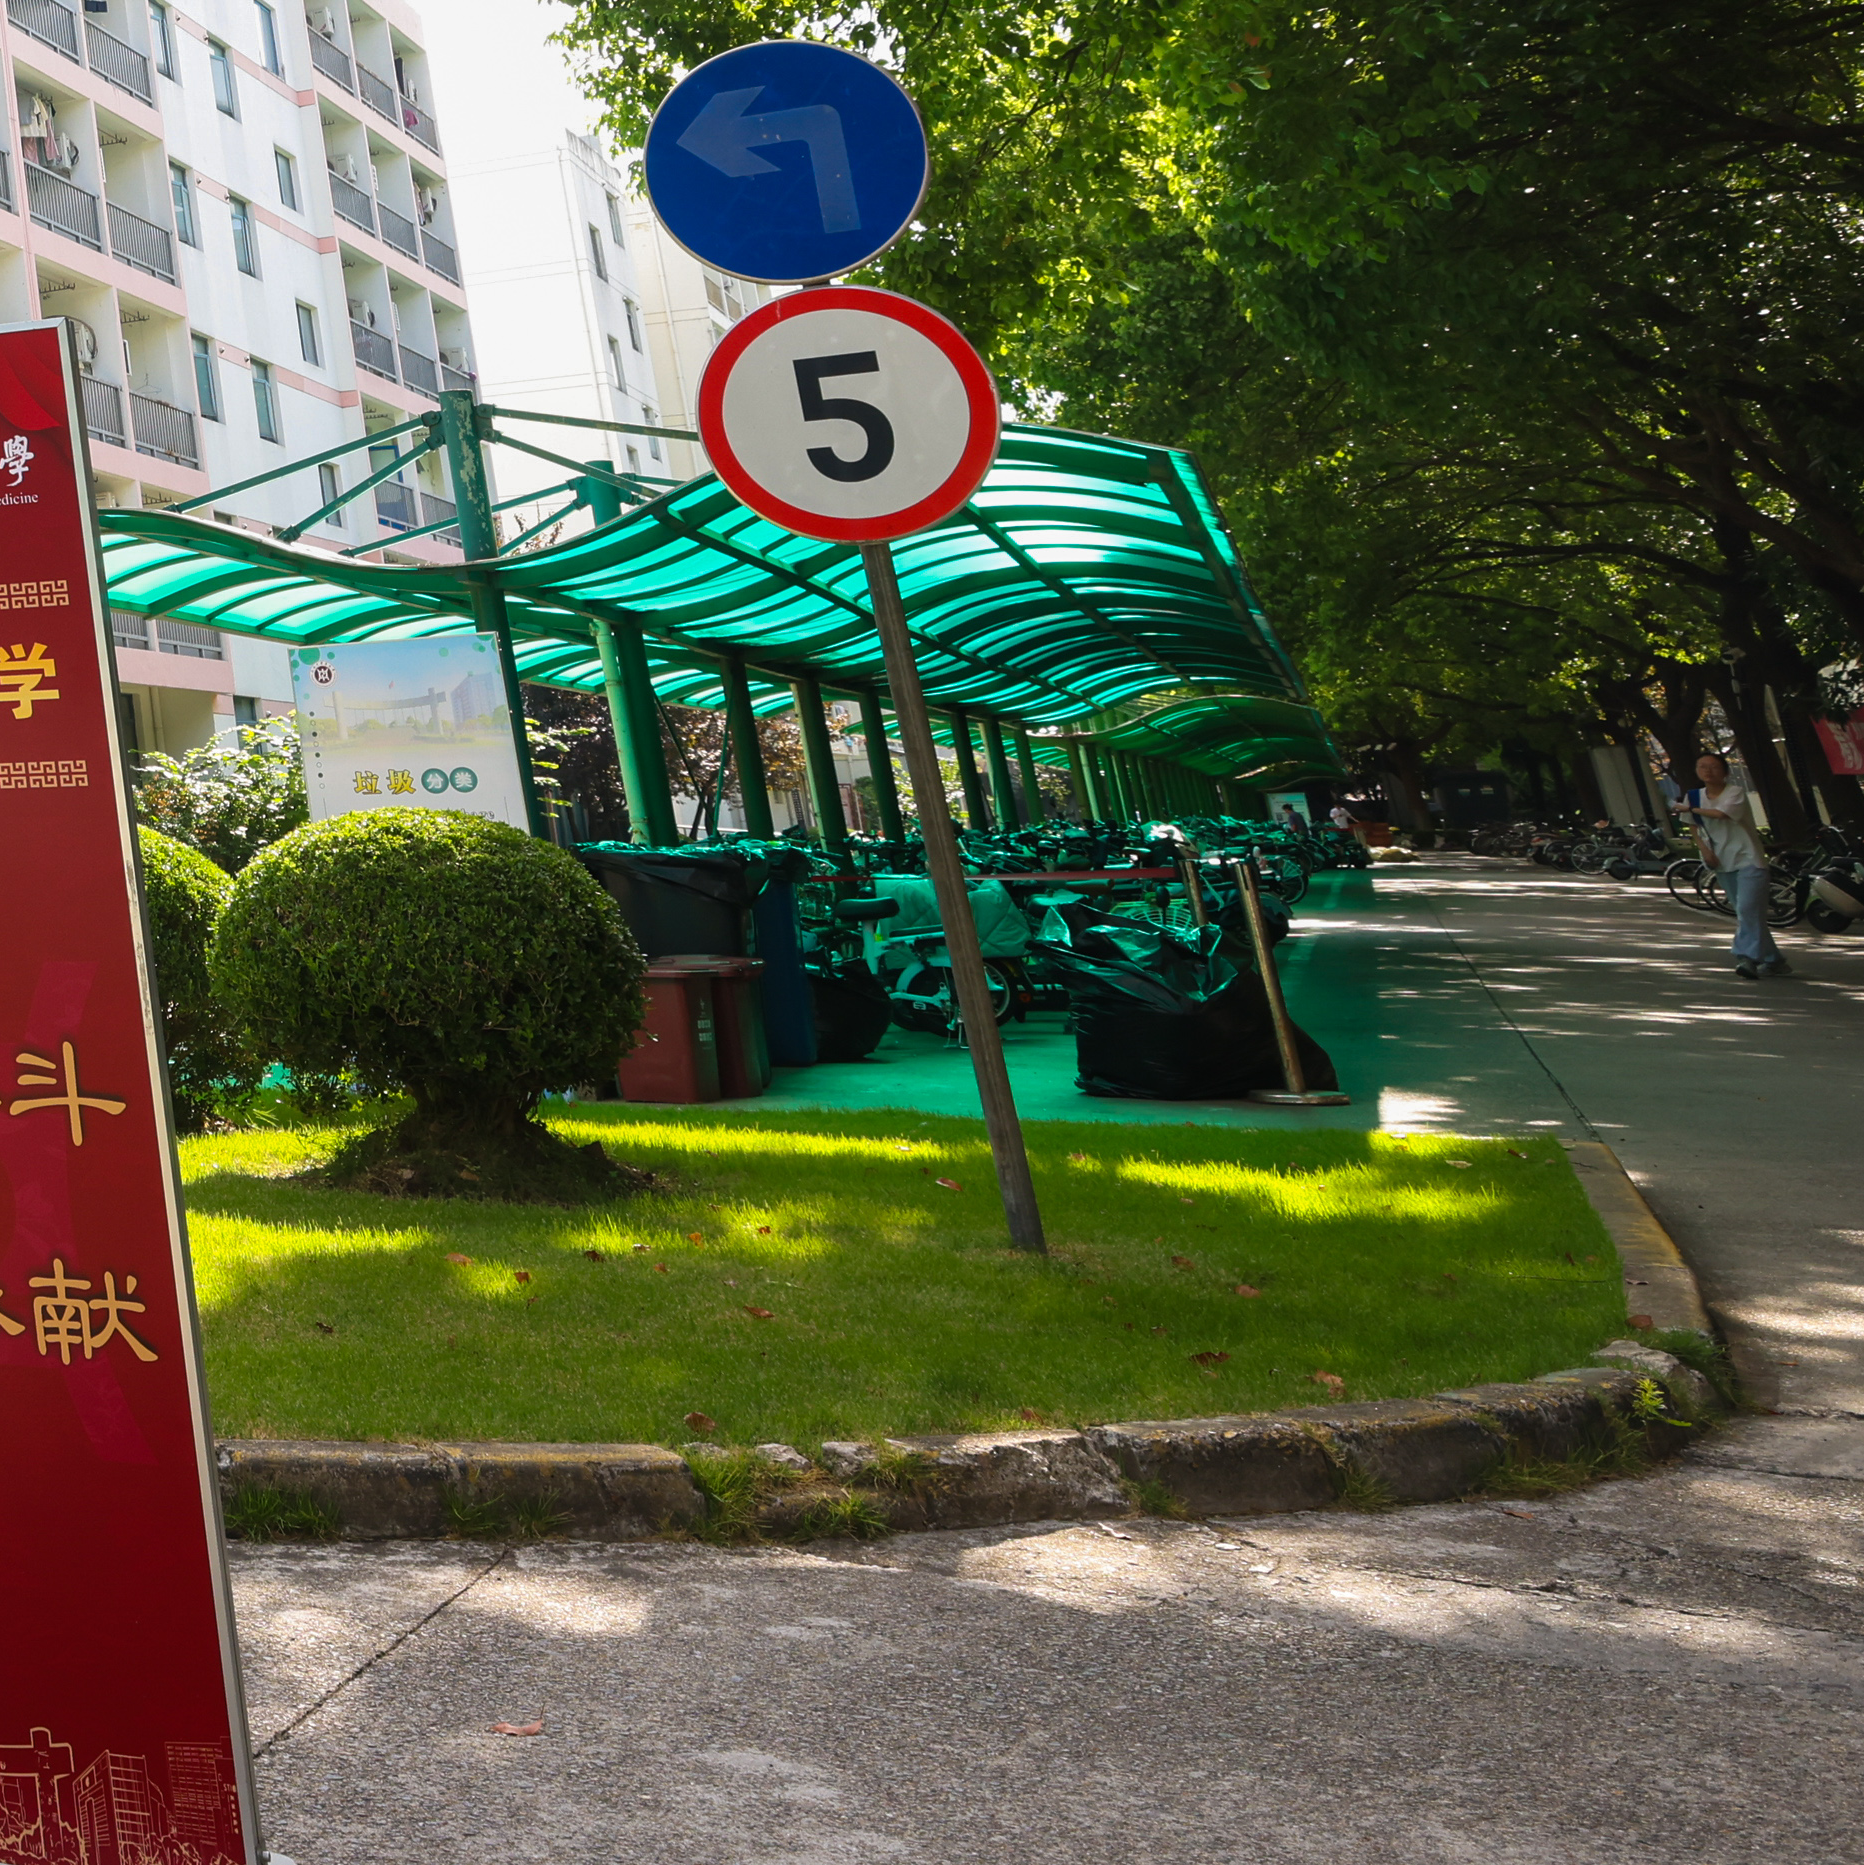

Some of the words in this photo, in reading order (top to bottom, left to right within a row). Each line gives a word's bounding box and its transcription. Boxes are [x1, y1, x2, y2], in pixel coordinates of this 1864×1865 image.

[792, 350, 895, 483] 5
[353, 768, 474, 795] 垃圾分类
